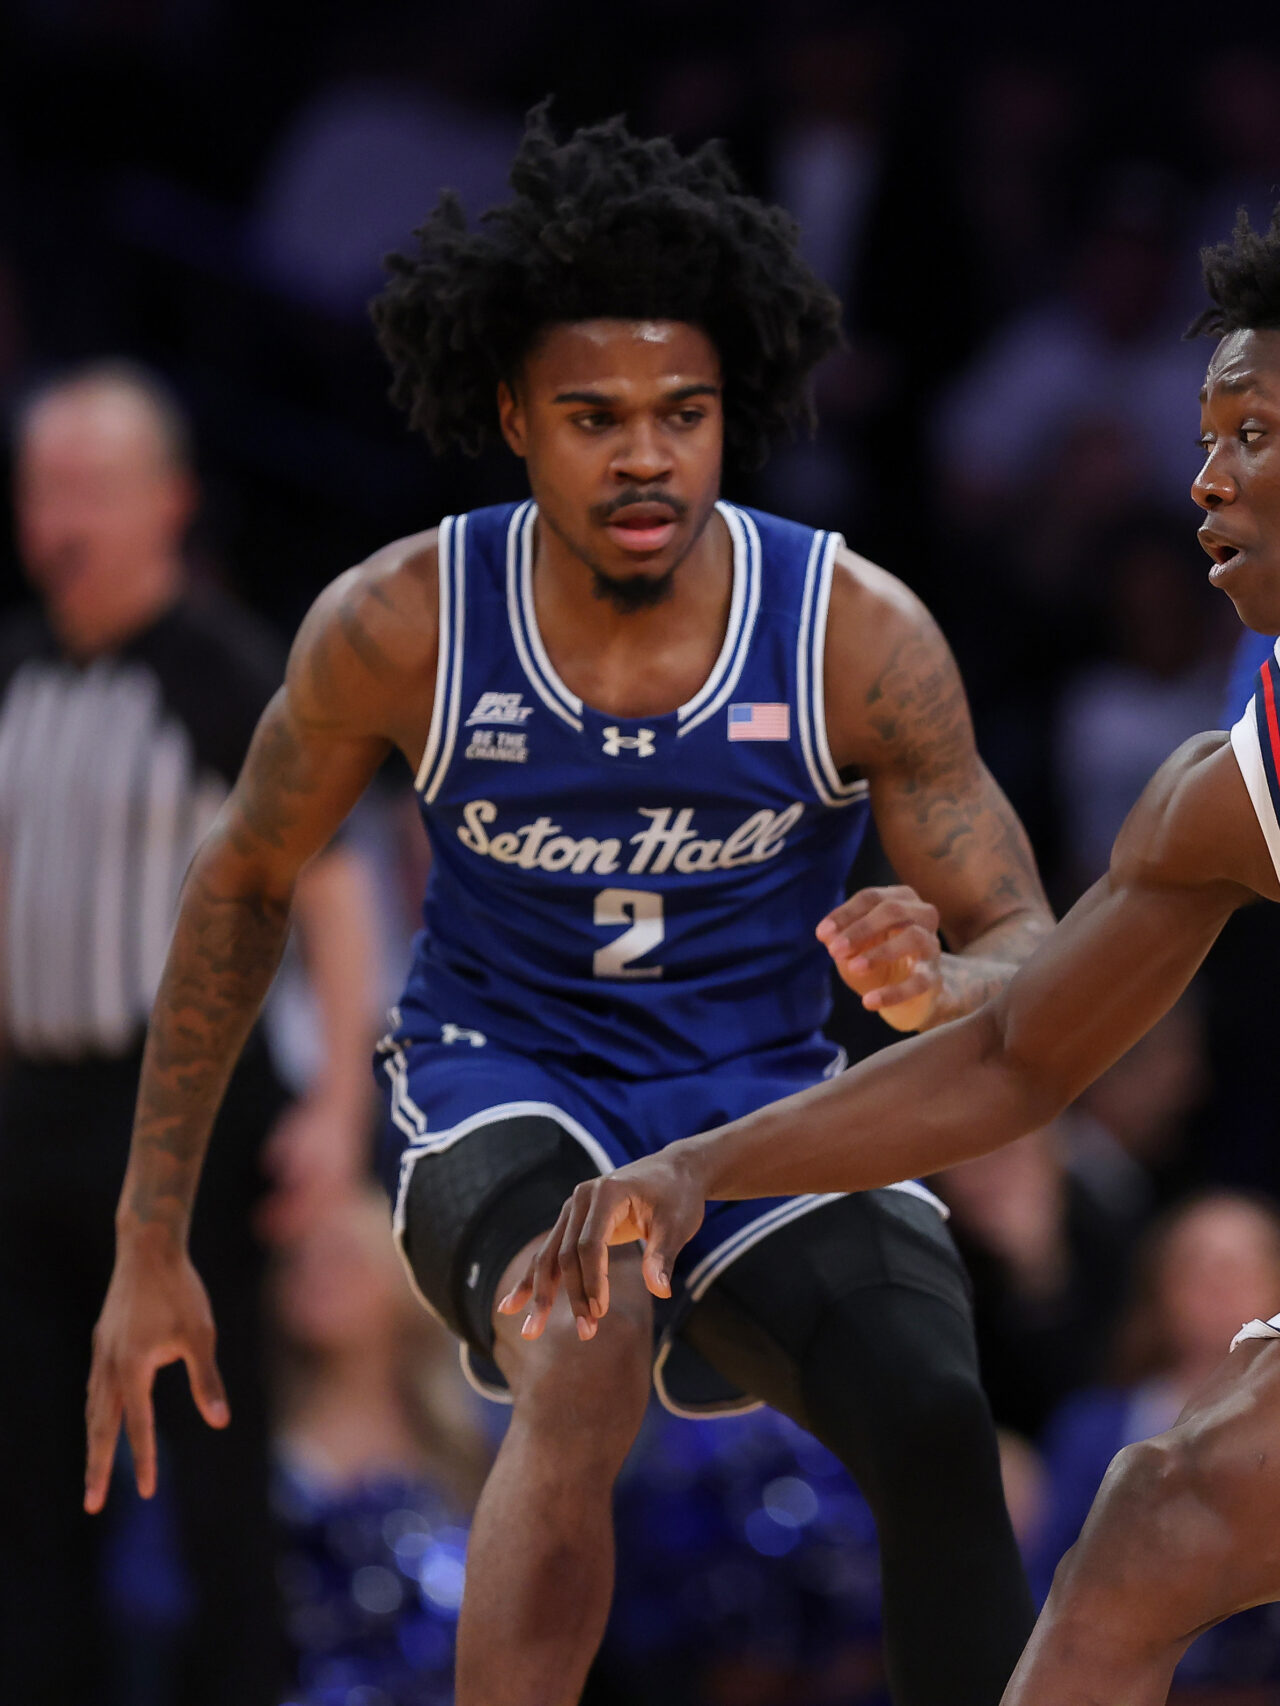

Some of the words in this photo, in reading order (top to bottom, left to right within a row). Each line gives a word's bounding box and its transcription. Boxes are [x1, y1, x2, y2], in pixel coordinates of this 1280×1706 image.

[456, 799, 622, 875] Seton
[629, 802, 805, 875] Hall
[592, 887, 666, 980] 2
